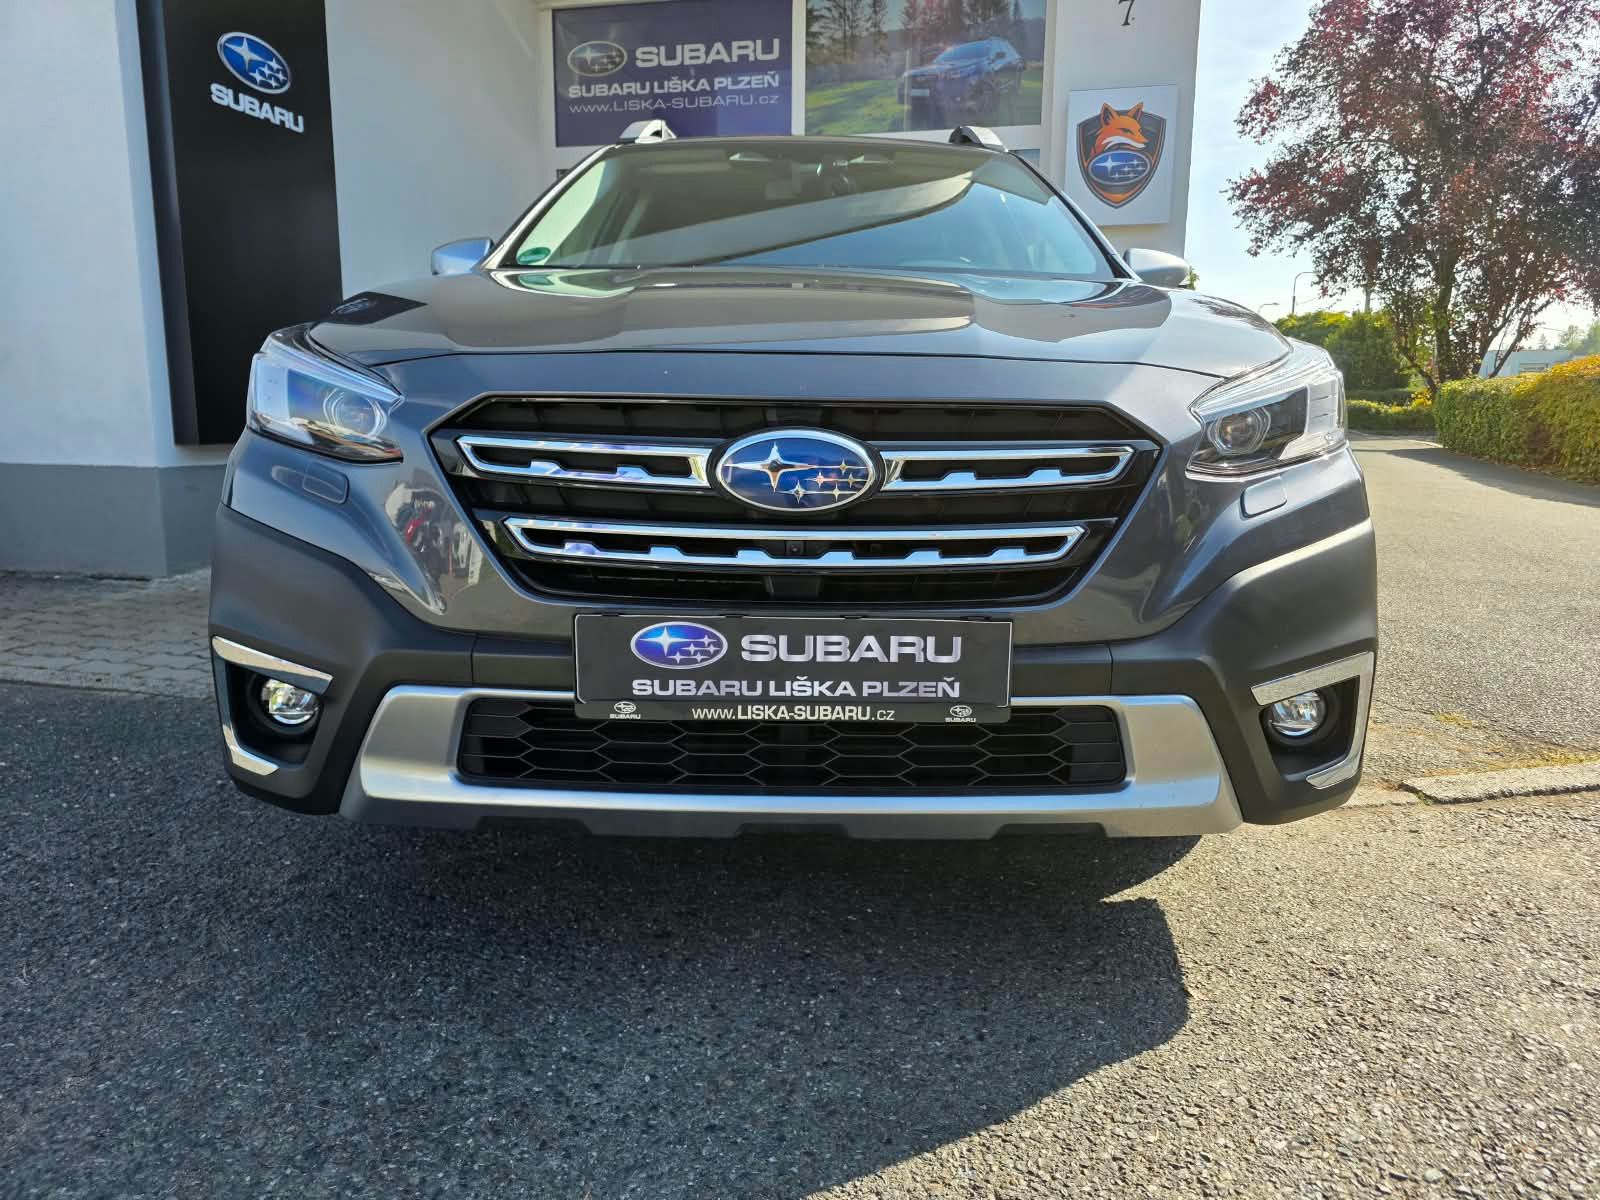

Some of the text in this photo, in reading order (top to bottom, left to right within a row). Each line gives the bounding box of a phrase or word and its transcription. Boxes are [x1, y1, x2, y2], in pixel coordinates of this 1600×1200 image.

[635, 38, 780, 68] SUBARU
[568, 71, 779, 99] SUBARU LIŠKA PLZEŇ
[210, 82, 304, 133] SUBARU
[569, 95, 779, 113] www.LISKA-SUBARU.cz
[741, 634, 962, 664] SUBARU
[632, 675, 960, 698] SUBARU LIŠKA PLZEŇ
[692, 705, 895, 721] www.LISKA-SUBARU.cz
